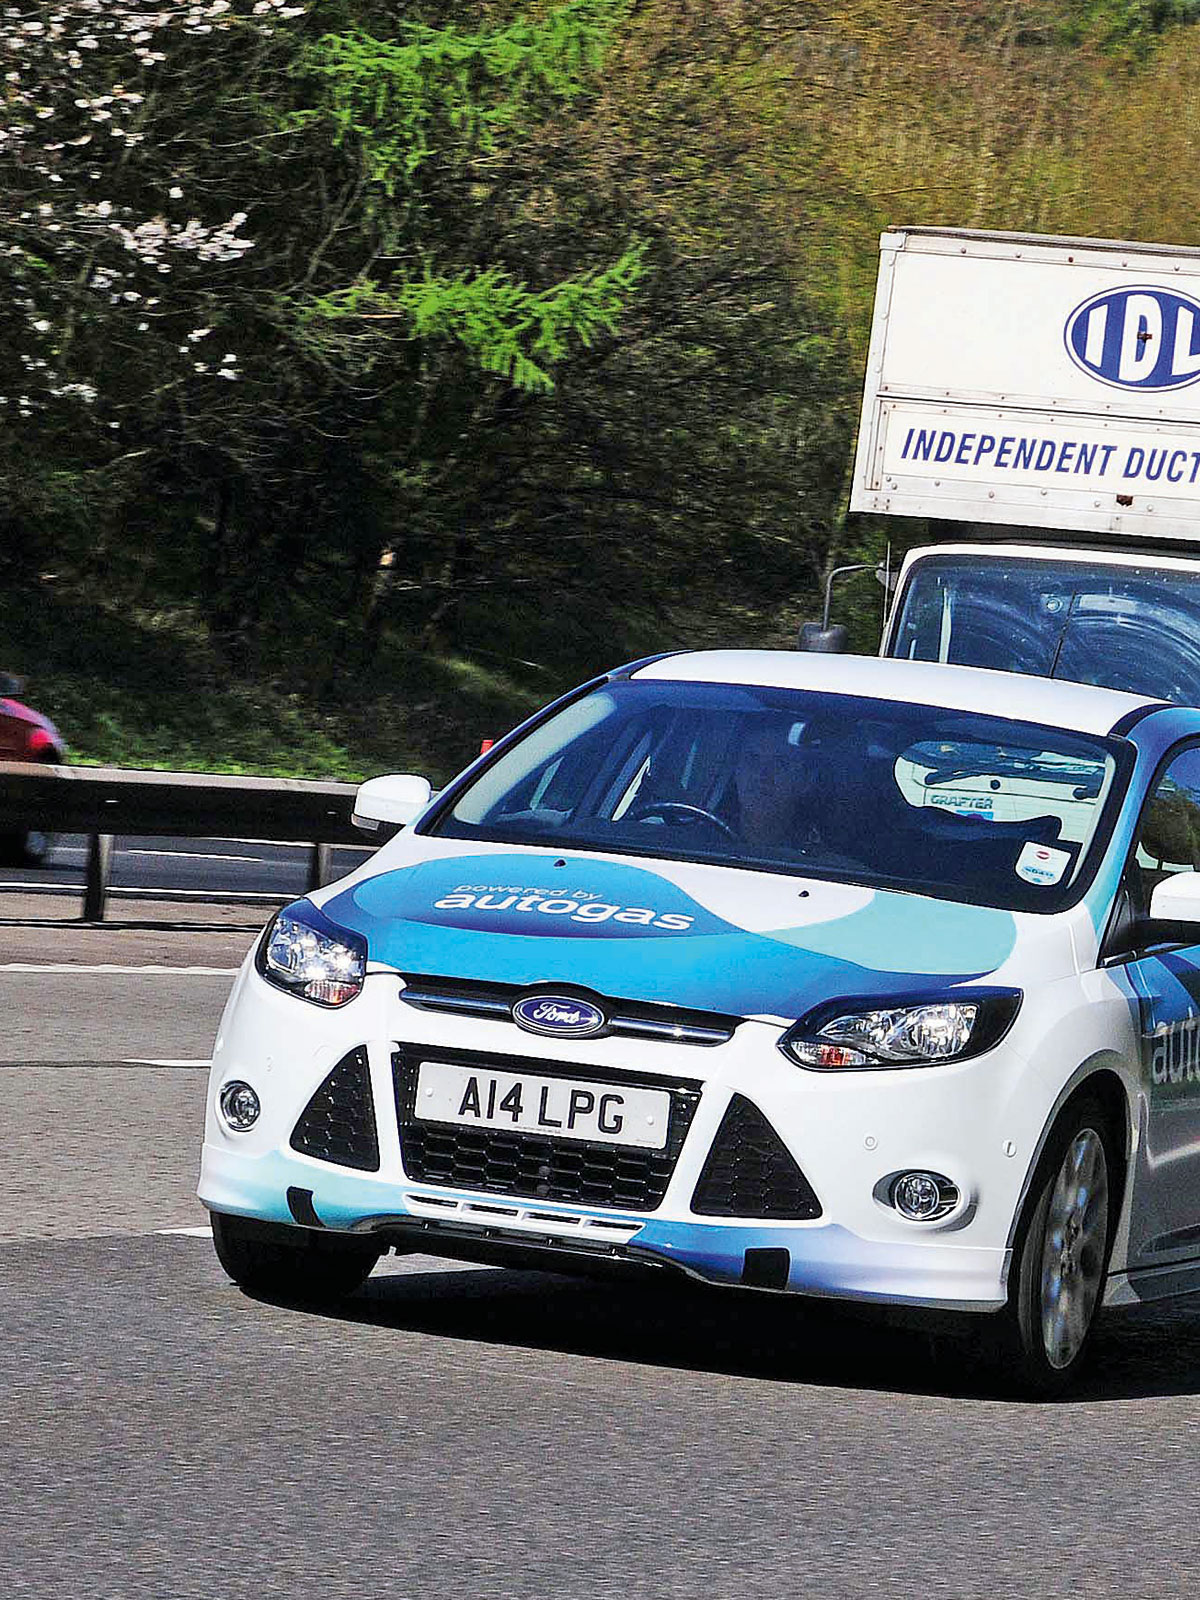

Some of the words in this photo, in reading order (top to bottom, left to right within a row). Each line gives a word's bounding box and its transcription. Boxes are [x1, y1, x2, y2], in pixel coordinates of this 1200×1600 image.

[901, 428, 1117, 476] INDEPENDENT
[931, 795, 994, 809] GRAFTER
[454, 884, 568, 896] powered
[572, 890, 602, 901] by
[435, 893, 694, 930] autogas
[532, 1002, 598, 1024] Ford
[458, 1077, 523, 1122] A14
[538, 1086, 625, 1134] LPG
